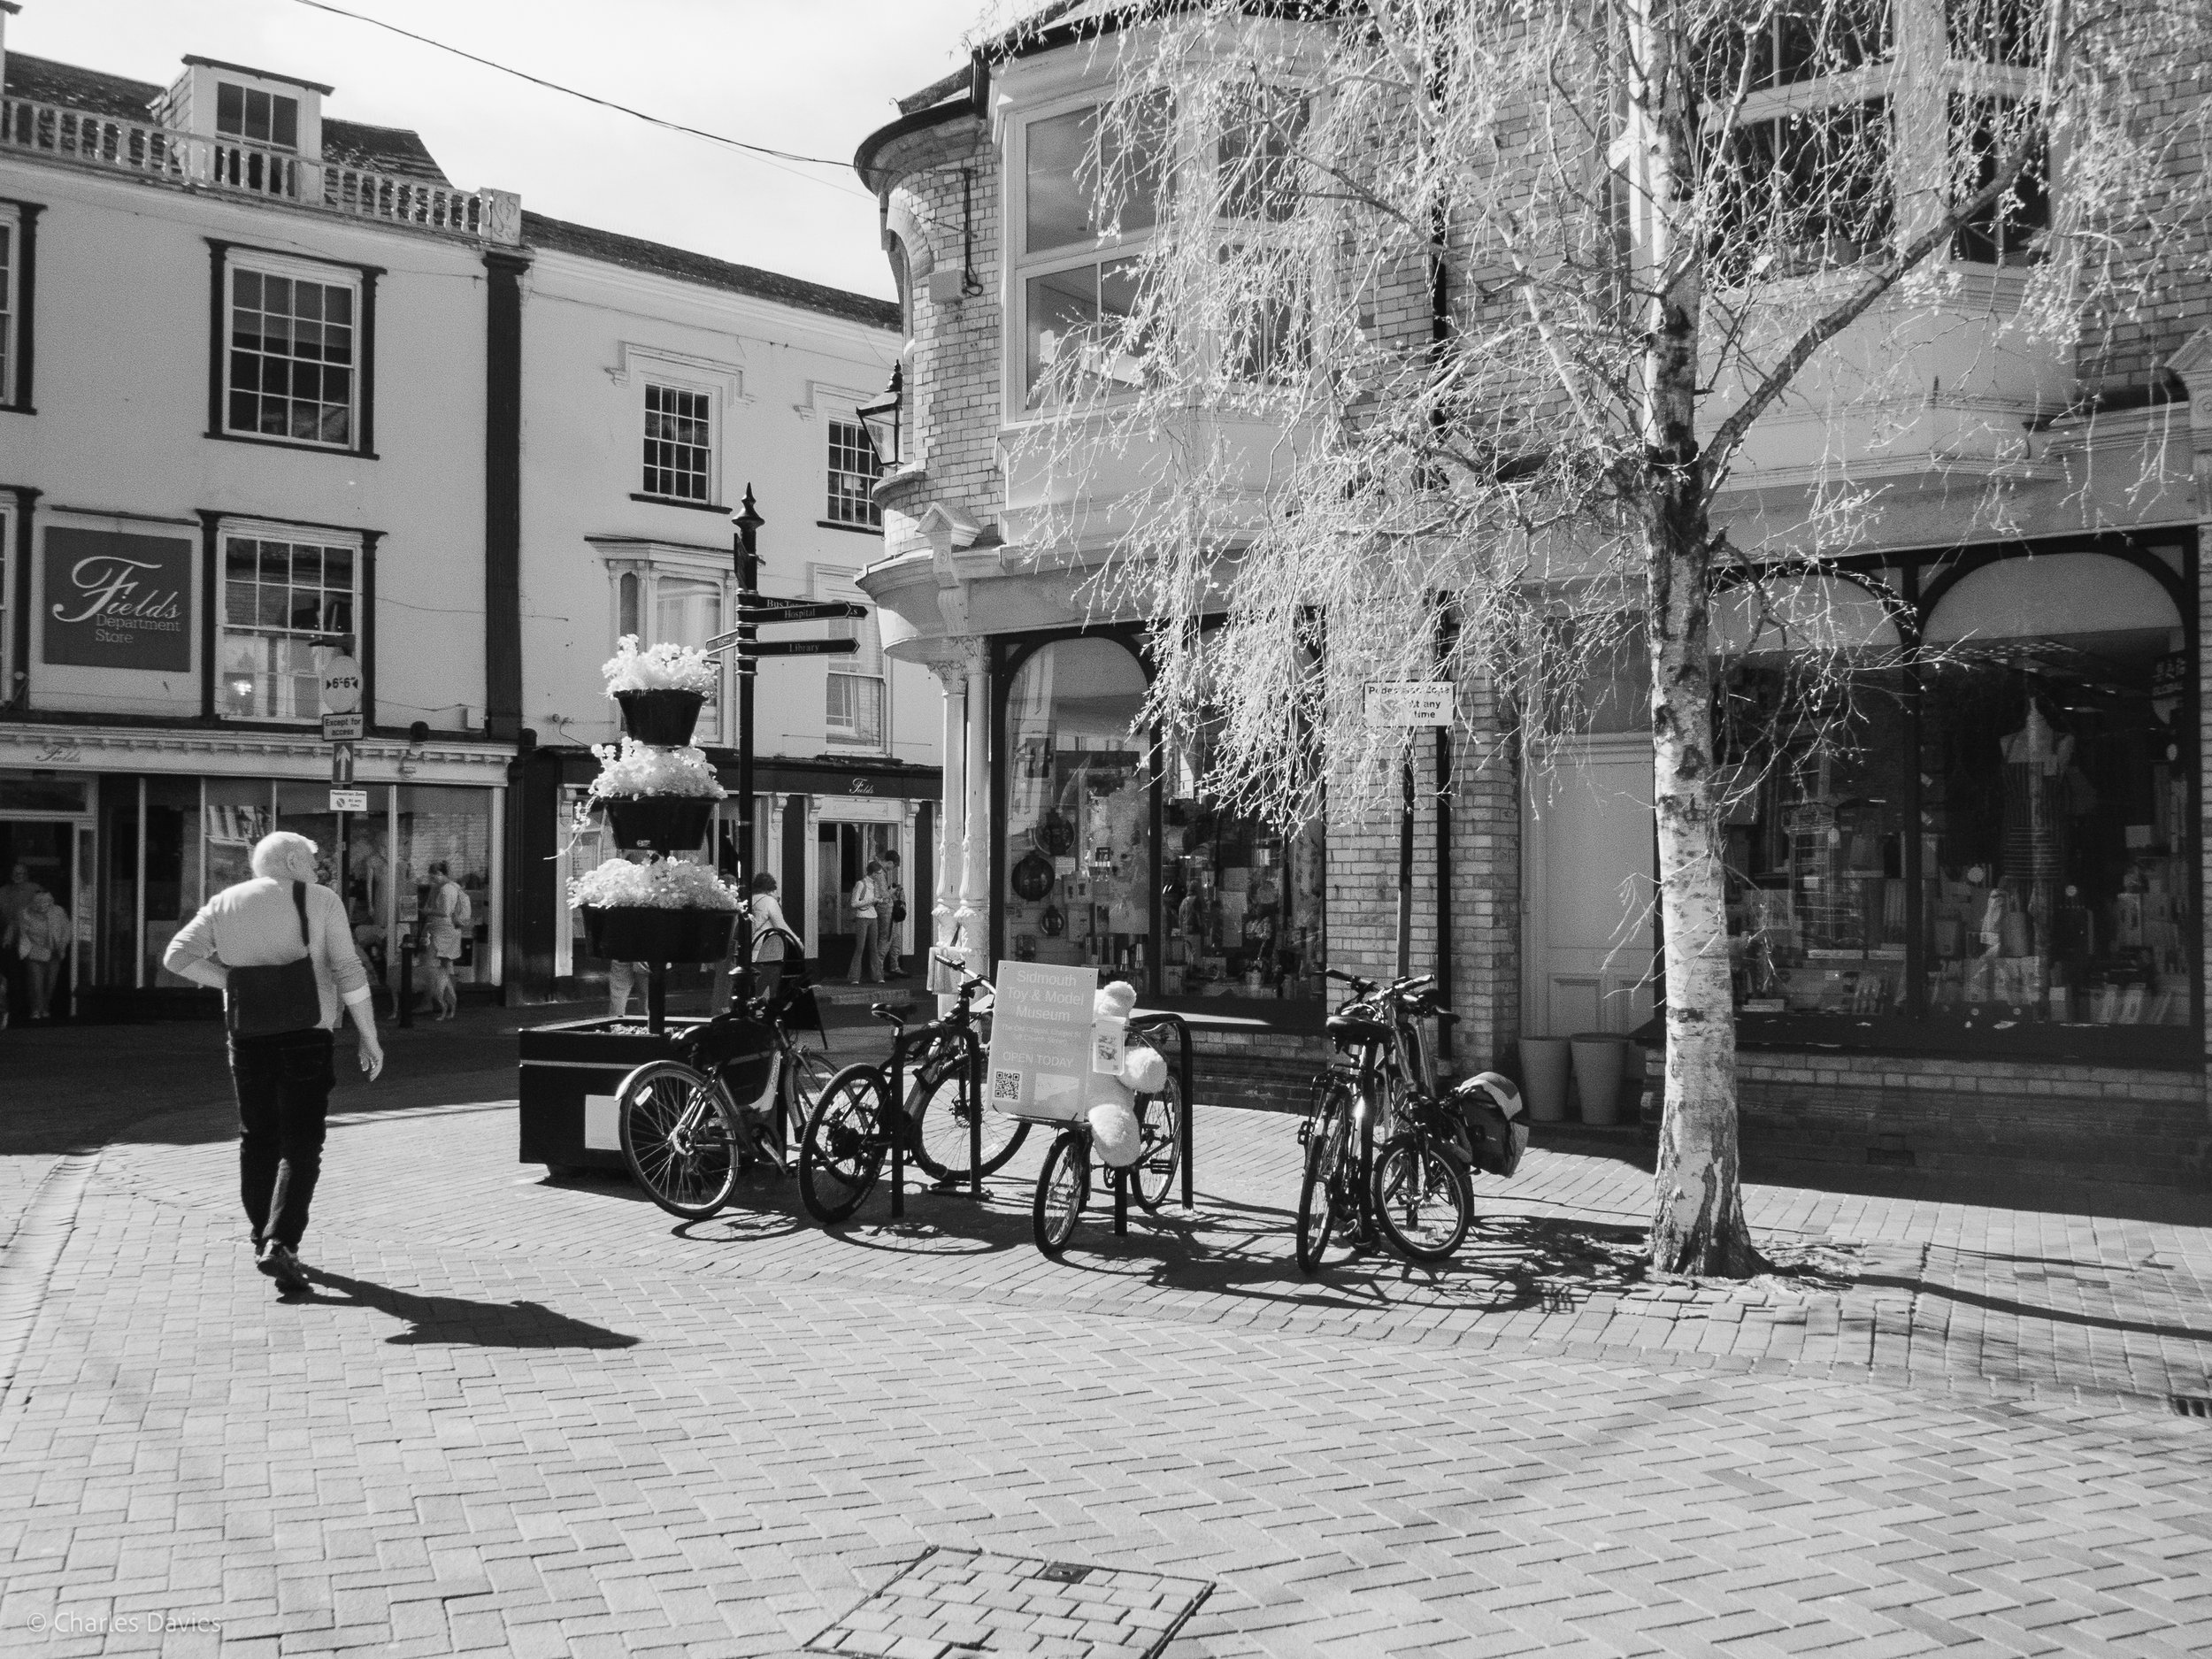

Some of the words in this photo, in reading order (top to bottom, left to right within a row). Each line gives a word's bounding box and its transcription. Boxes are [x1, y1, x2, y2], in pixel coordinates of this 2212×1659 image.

[52, 556, 180, 622] Fields
[767, 599, 783, 608] Bus
[785, 608, 816, 619] Hospital
[96, 613, 181, 632] Department
[96, 629, 134, 644] Store
[789, 642, 820, 653] Library
[1423, 701, 1441, 710] any
[325, 718, 349, 726] Except
[350, 717, 362, 726] for
[849, 778, 874, 794] Fields
[1017, 969, 1077, 987] Sidmouth
[1007, 987, 1029, 1002] Toy
[1031, 989, 1041, 1002] &
[1045, 990, 1084, 1006] Model
[1016, 1004, 1071, 1022] Museum
[1002, 1050, 1033, 1064] OPEN
[1036, 1053, 1074, 1068] TODAY
